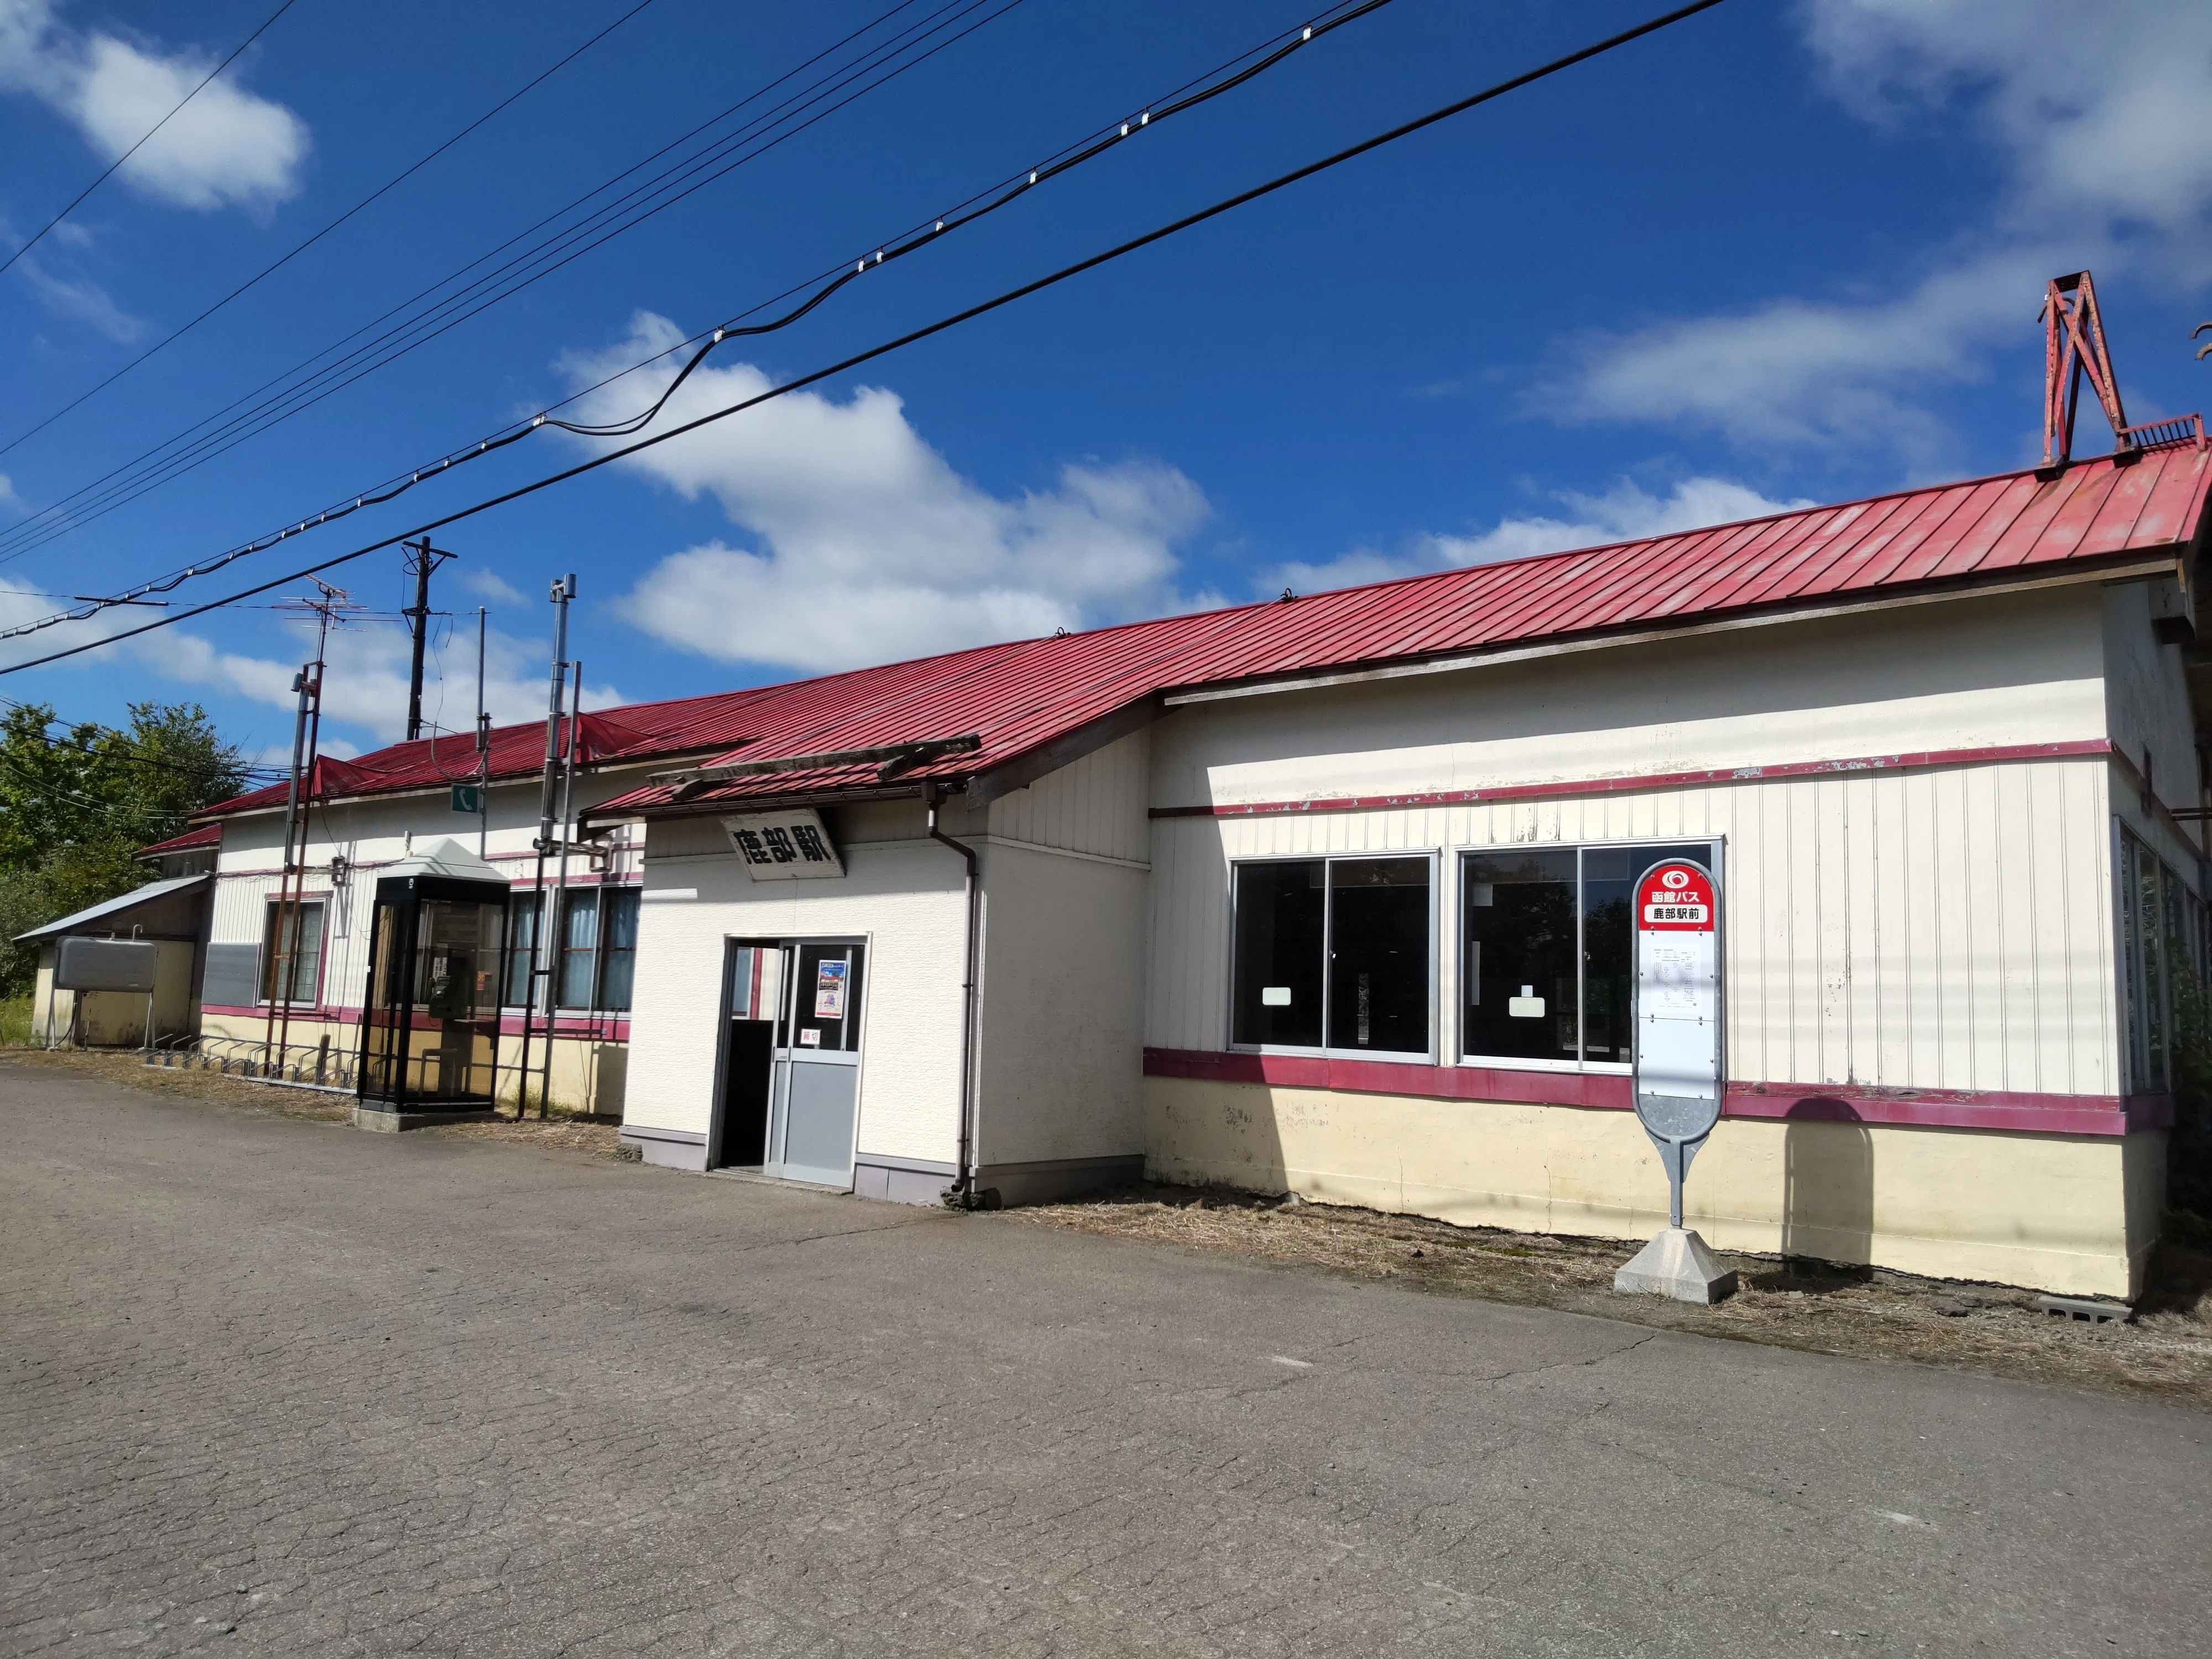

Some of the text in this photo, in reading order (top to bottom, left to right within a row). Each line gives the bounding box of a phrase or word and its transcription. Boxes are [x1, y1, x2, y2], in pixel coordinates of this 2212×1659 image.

[733, 825, 831, 864] 鹿部駅
[1651, 891, 1699, 902] 函館バス
[1653, 907, 1699, 919] 鹿部駅前
